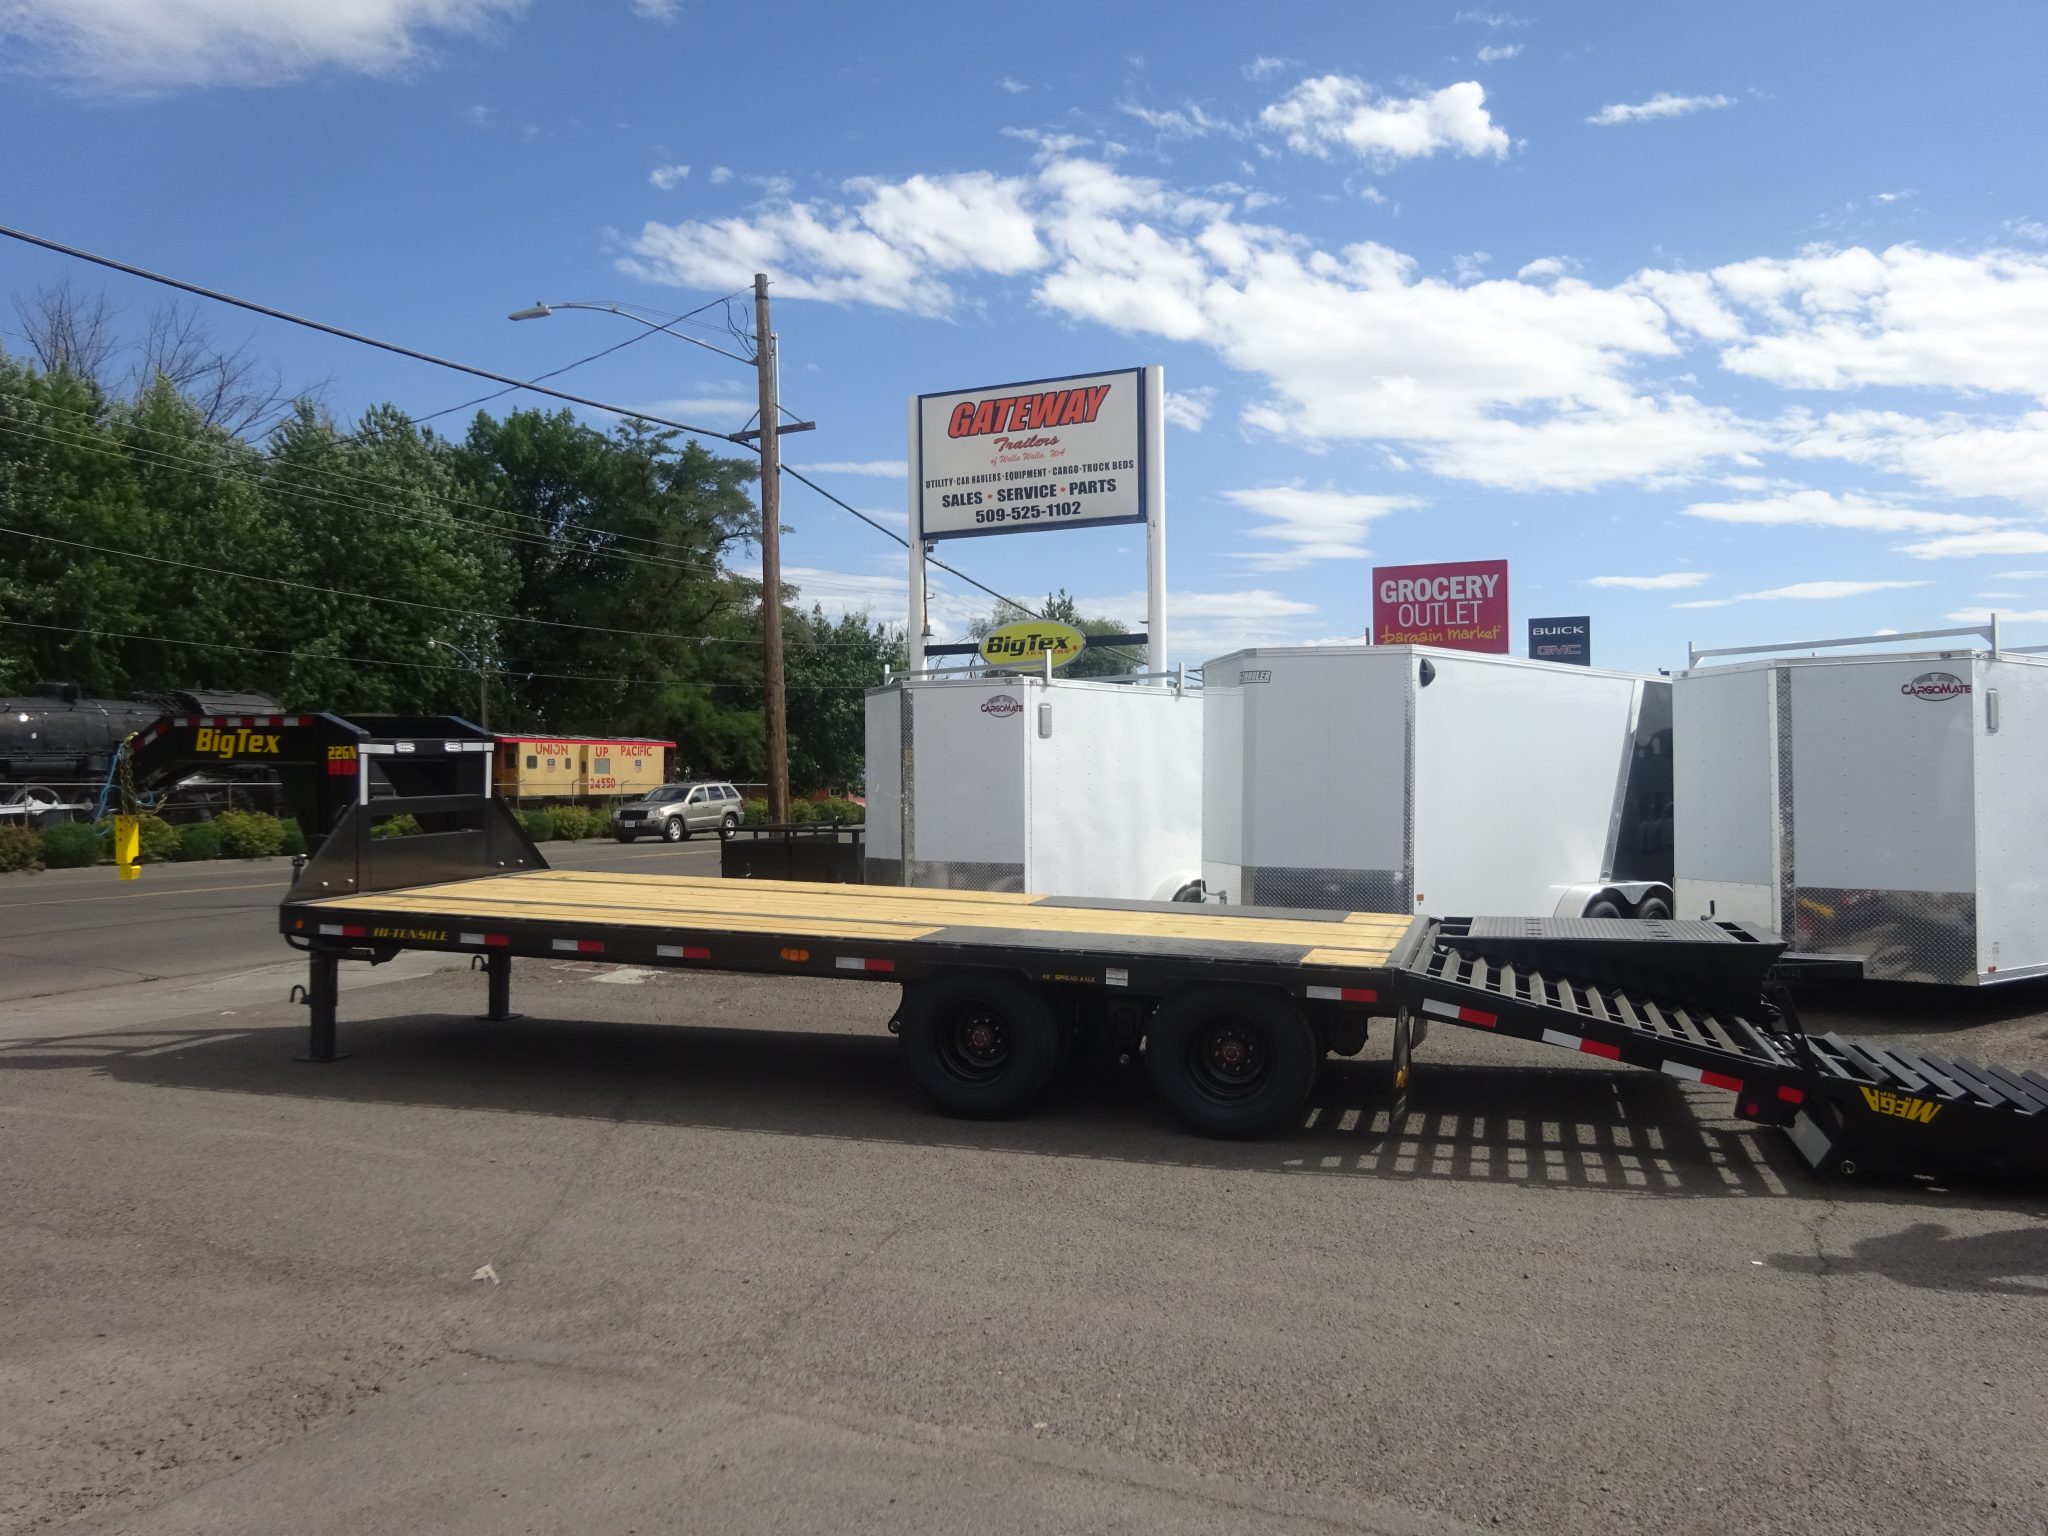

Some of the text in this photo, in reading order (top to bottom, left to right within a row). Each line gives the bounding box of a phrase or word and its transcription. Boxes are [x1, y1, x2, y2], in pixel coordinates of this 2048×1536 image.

[948, 384, 1111, 439] GATEWAY
[993, 434, 1059, 452] Trailers
[990, 456, 997, 465] of
[1000, 454, 1020, 463] Walla
[1050, 448, 1065, 457] WA
[925, 459, 1134, 489] UTILITY CAR HAULERS EQUIPMENT CARGO TRUCK BEDS
[942, 478, 1117, 508] SALES SERVICE PARTS
[975, 501, 1081, 524] 509-525-1102
[1380, 574, 1499, 604] GROCERY
[1398, 600, 1483, 628] OUTLET
[1380, 624, 1500, 645] bargain market
[1532, 625, 1584, 636] BUICK
[986, 634, 1070, 657] BigTex
[1537, 644, 1581, 656] GMC
[196, 728, 281, 759] BigTex
[535, 743, 653, 758] UNION UP PACIFIC
[589, 777, 616, 789] 24550
[373, 927, 448, 941] HI-TENSILE
[1859, 1086, 1943, 1123] MEGA
